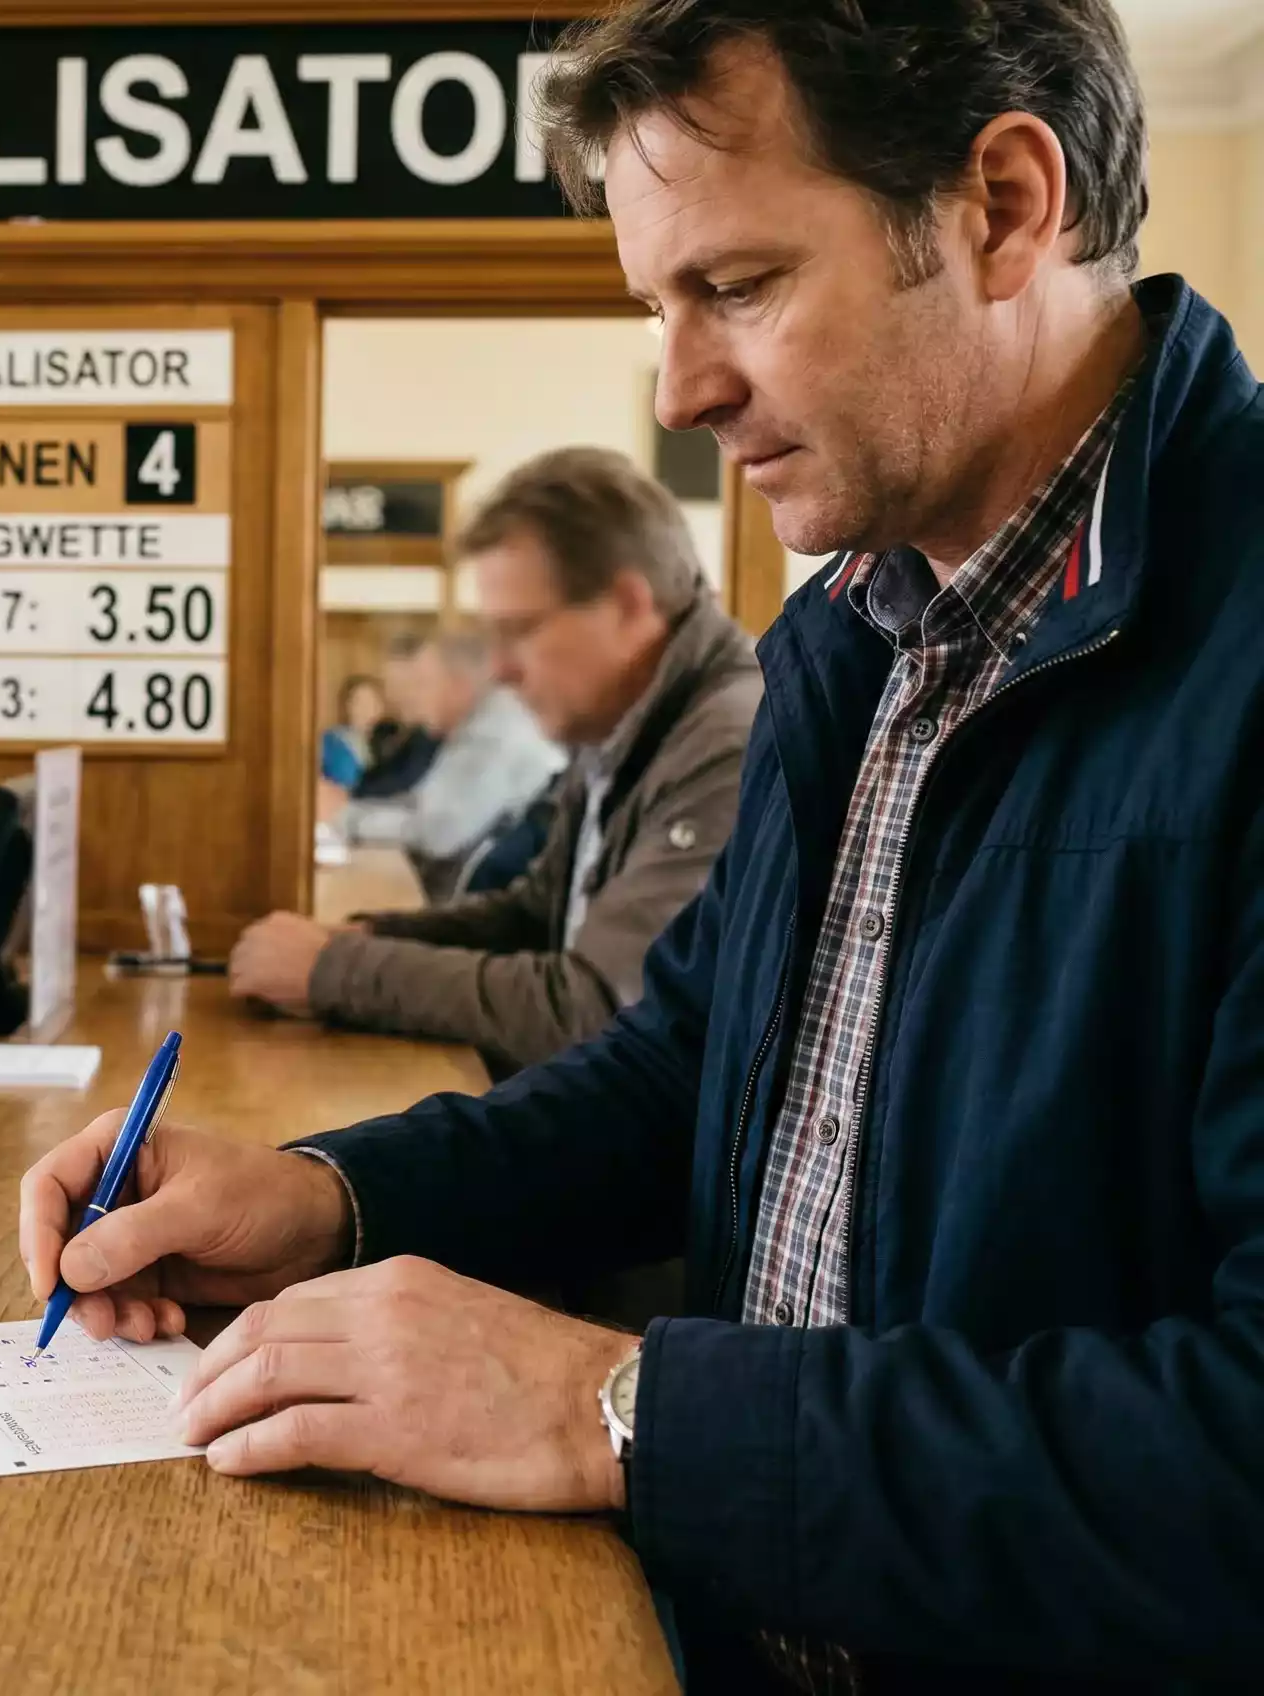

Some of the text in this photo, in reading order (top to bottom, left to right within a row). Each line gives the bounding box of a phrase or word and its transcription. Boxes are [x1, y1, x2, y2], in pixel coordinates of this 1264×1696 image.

[138, 431, 180, 495] 4
[1, 592, 38, 632] 7:
[89, 584, 213, 643] 3.50
[1, 678, 38, 720] 3:
[86, 672, 213, 732] 4.80
